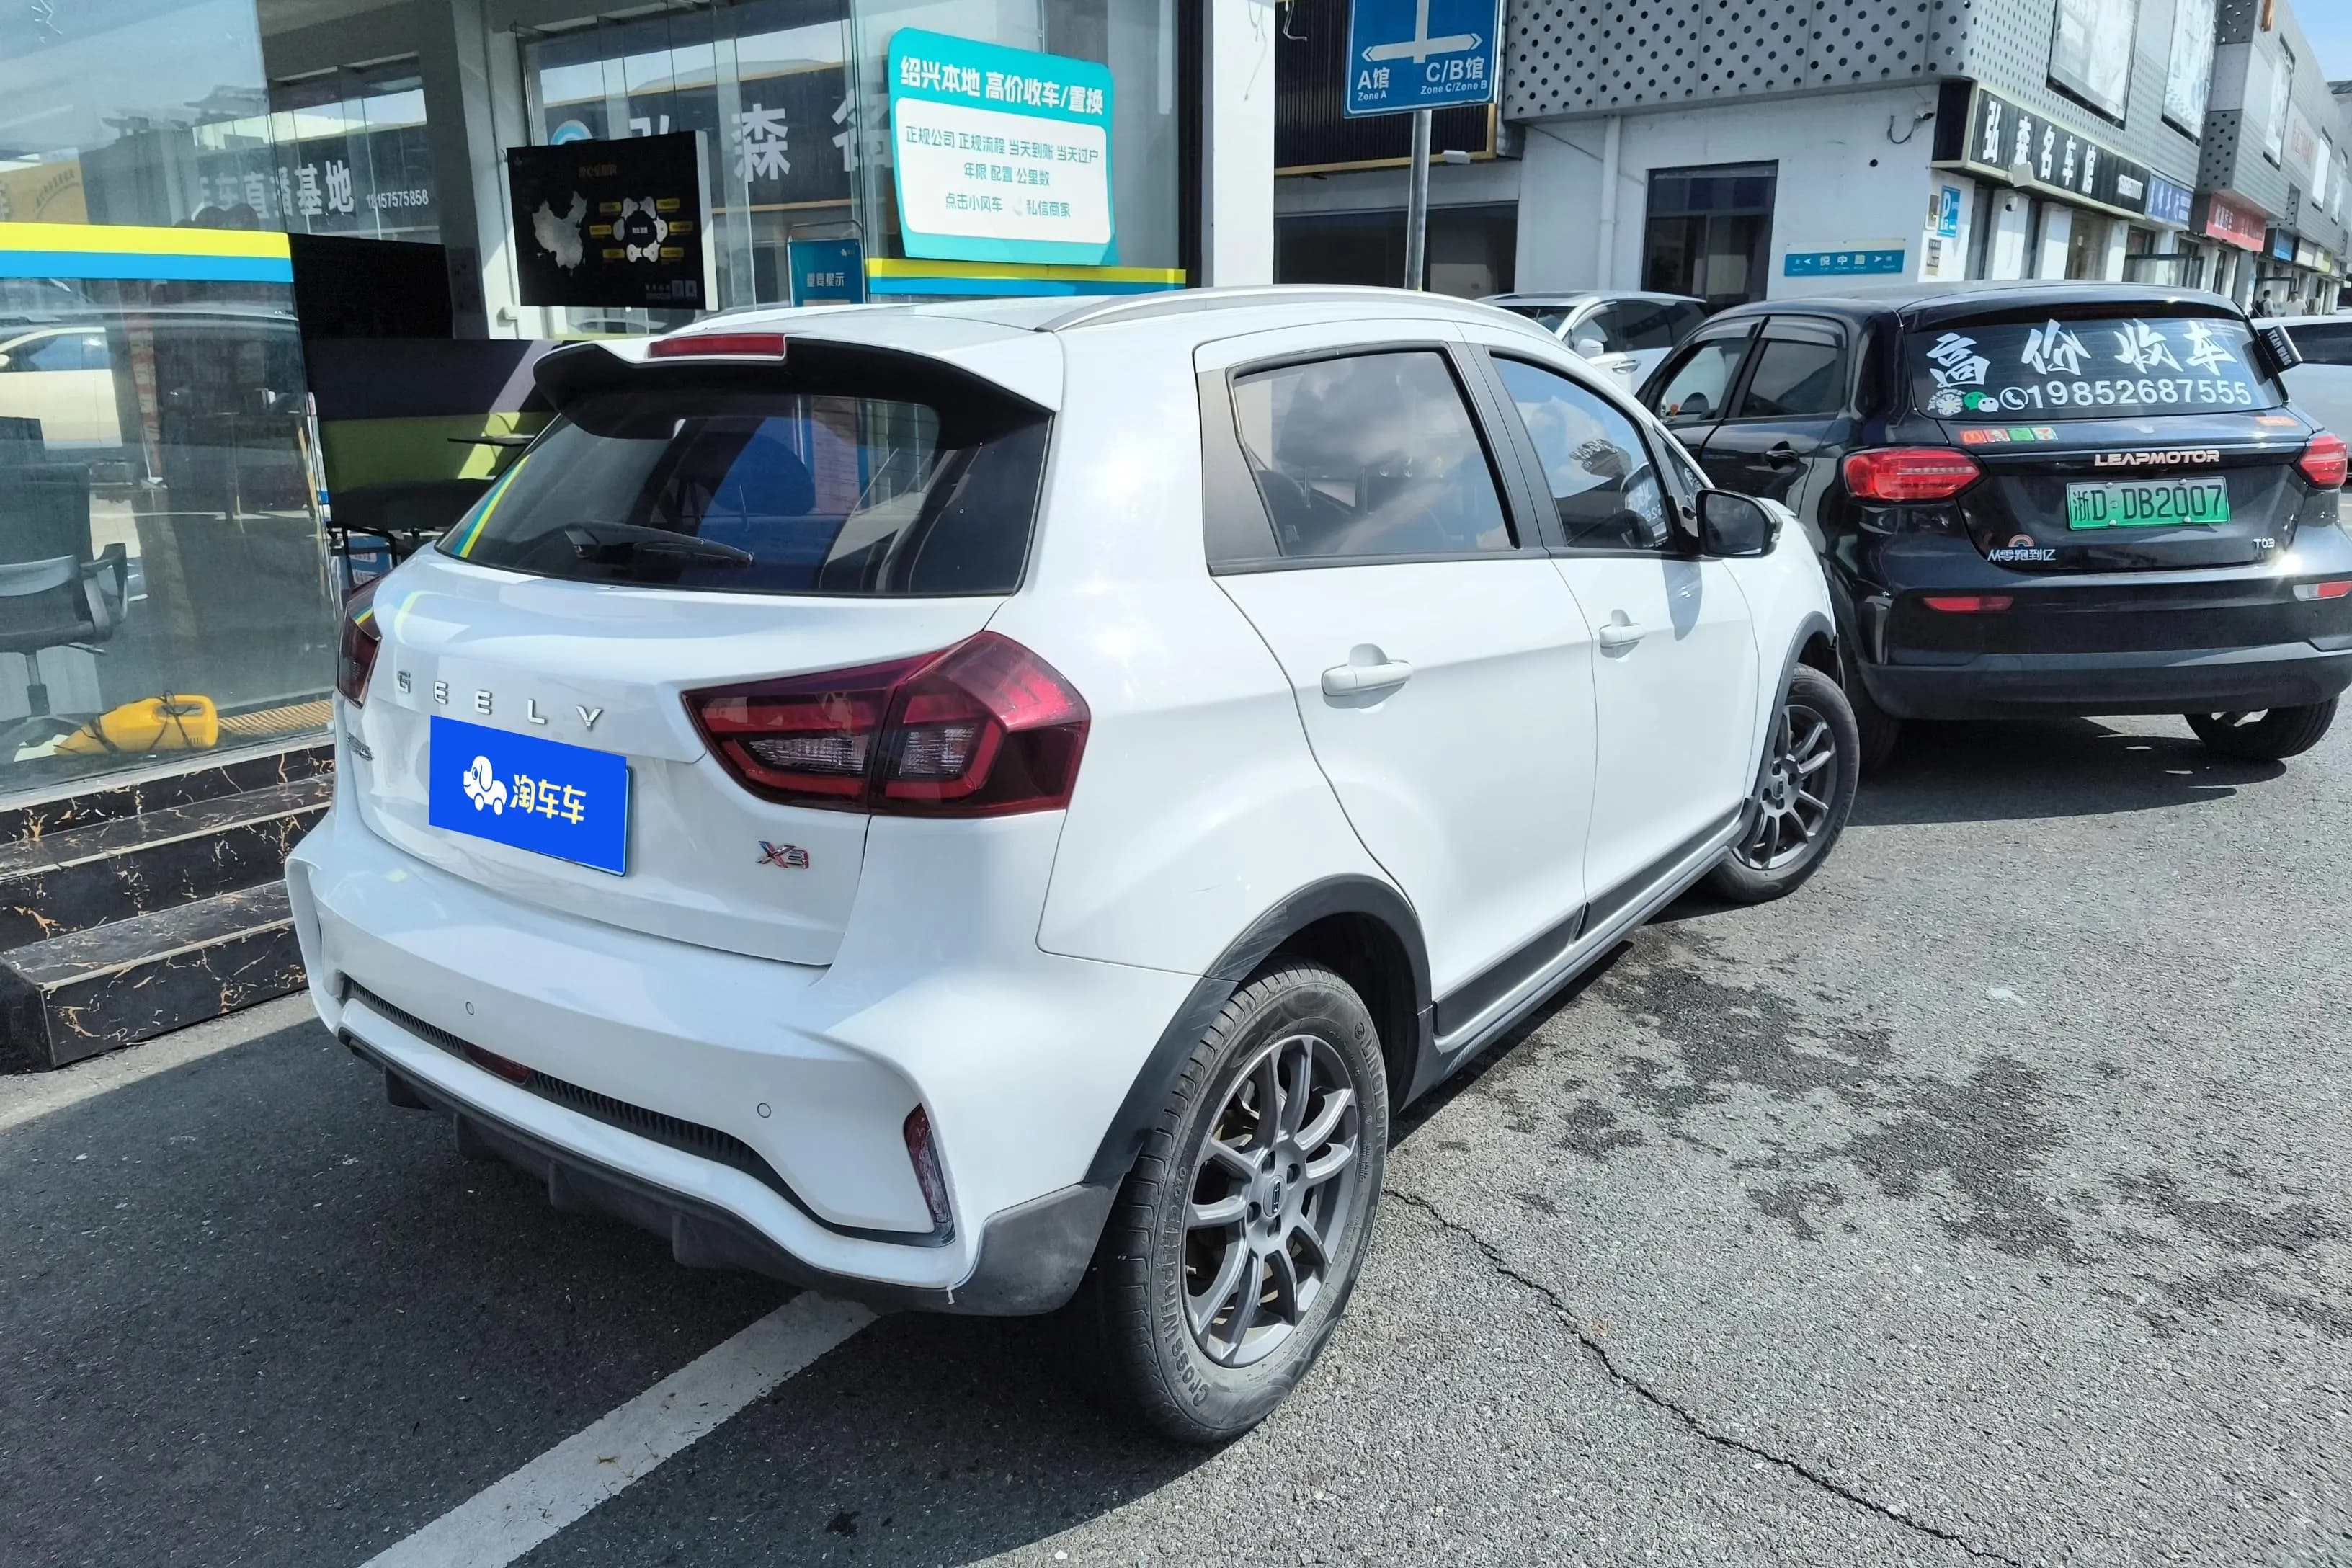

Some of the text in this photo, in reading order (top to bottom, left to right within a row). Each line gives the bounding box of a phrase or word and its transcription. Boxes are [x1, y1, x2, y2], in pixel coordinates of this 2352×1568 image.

[1357, 67, 1391, 90] A馆
[1426, 55, 1485, 84] C/B馆
[900, 55, 1104, 115] 绍兴本地 高价收车/置换
[1358, 90, 1387, 101] Zone A
[1420, 80, 1487, 95] Zone C/Zone B
[906, 125, 1099, 164] 正规公司 正规流程 当天到账 当天过户
[963, 162, 1050, 186] 年限 配置 公里数
[945, 192, 1072, 218] 点击小风车 私信商家
[806, 272, 845, 288] 重要提示
[2026, 379, 2253, 409] 19852687555
[2094, 450, 2220, 467] LEAPMOTOR
[2121, 484, 2222, 520] DB2007
[1987, 548, 2057, 561] 从零跑到亿
[2253, 538, 2275, 548] T03
[396, 669, 603, 731] GEELY
[755, 839, 810, 870] X3
